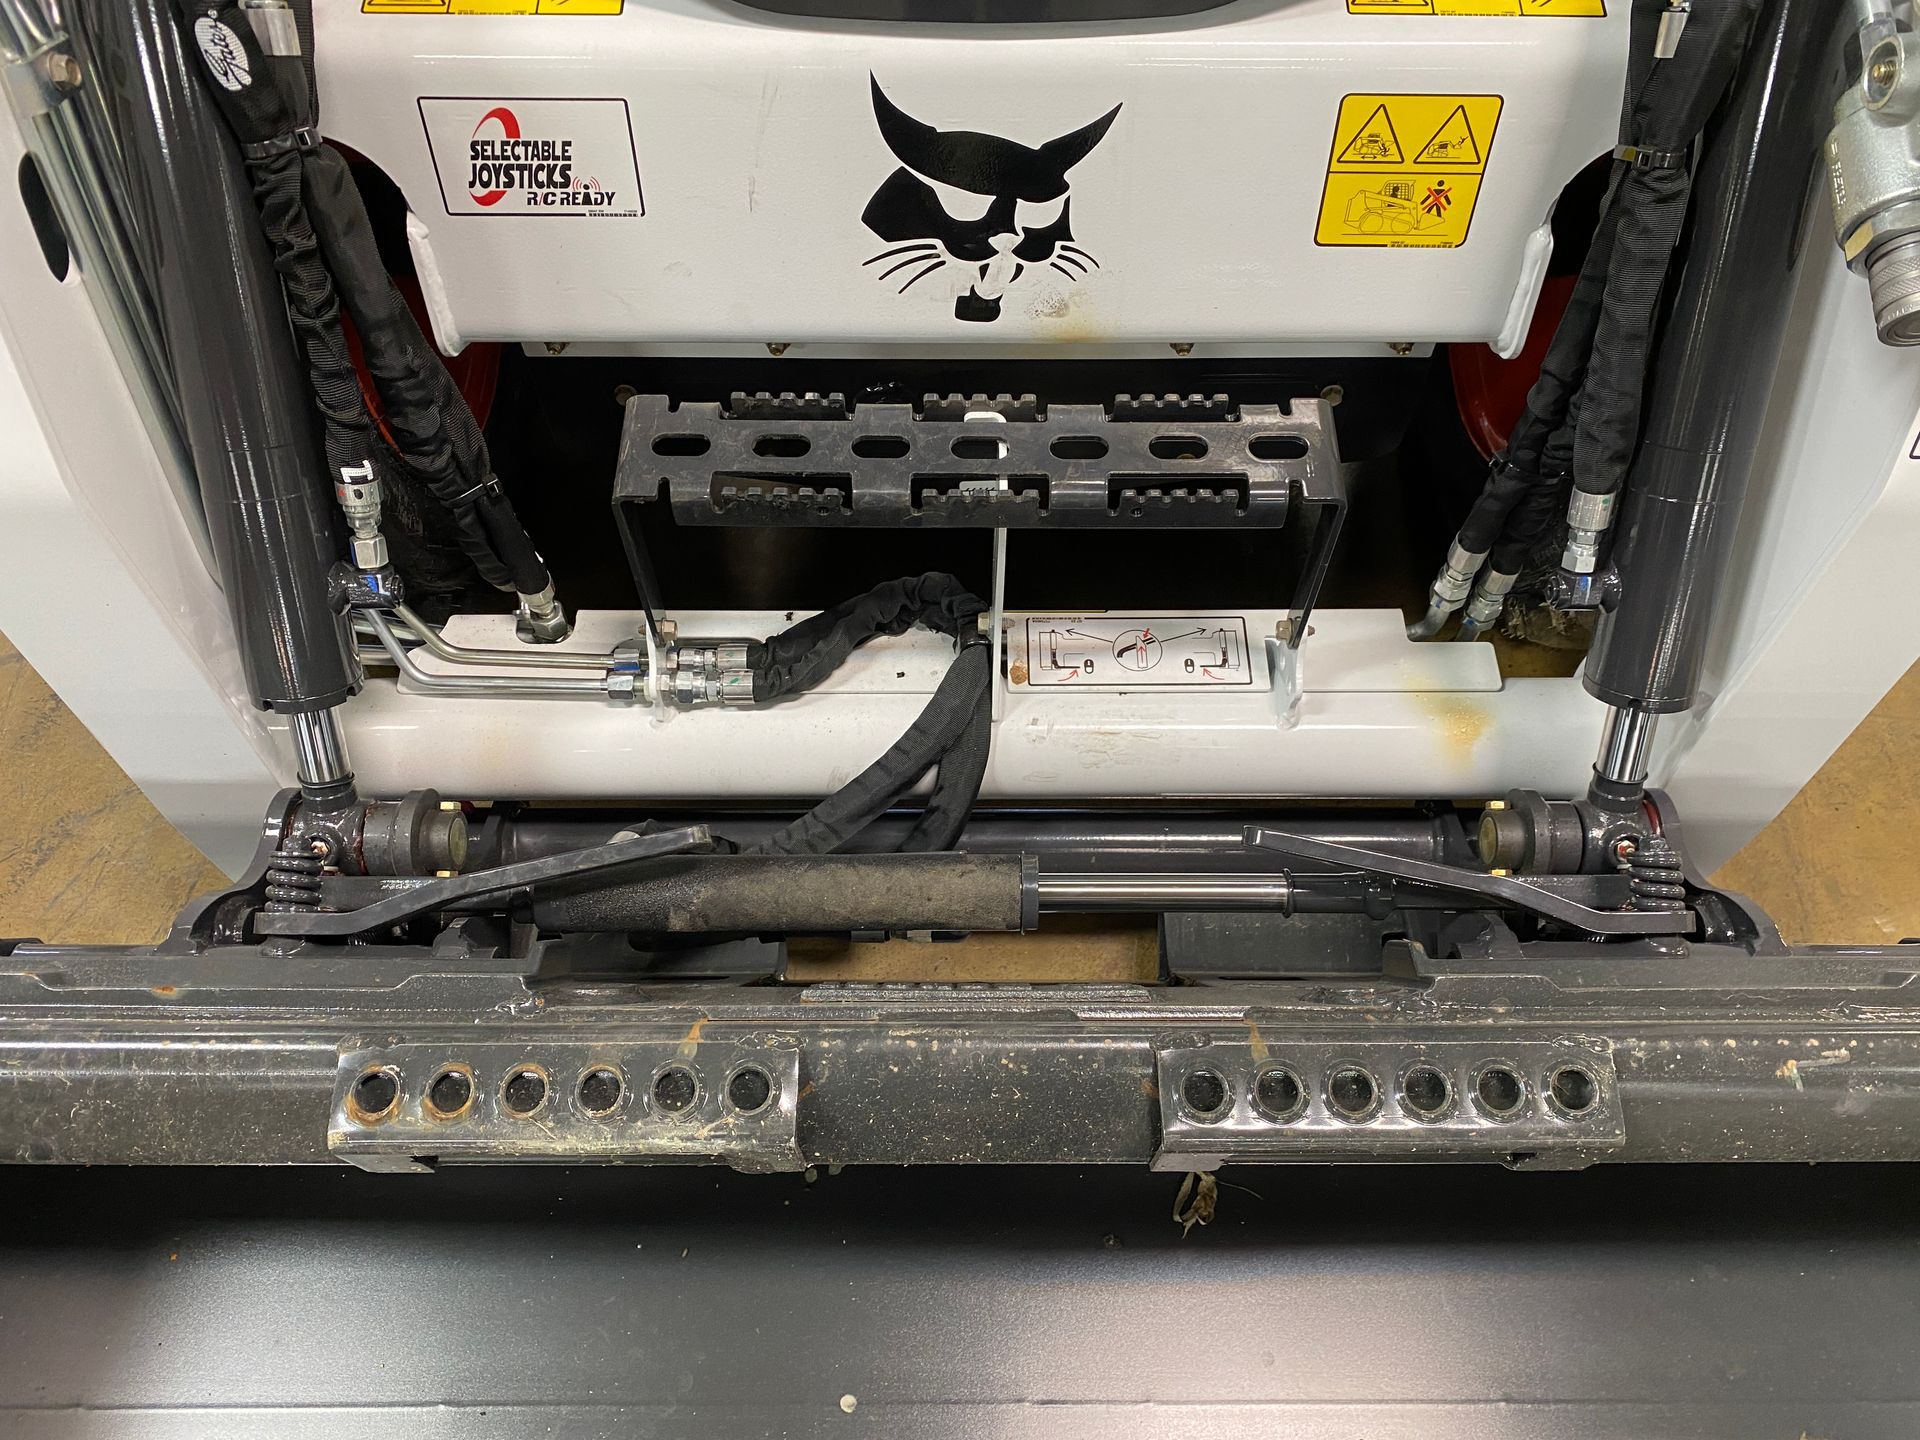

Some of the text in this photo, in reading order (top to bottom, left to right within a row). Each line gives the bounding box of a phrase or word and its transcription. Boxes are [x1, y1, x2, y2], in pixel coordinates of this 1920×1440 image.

[469, 139, 573, 162] SELECTABLE
[468, 163, 573, 189] JOYSTICKS
[526, 190, 616, 206] R/C READY
